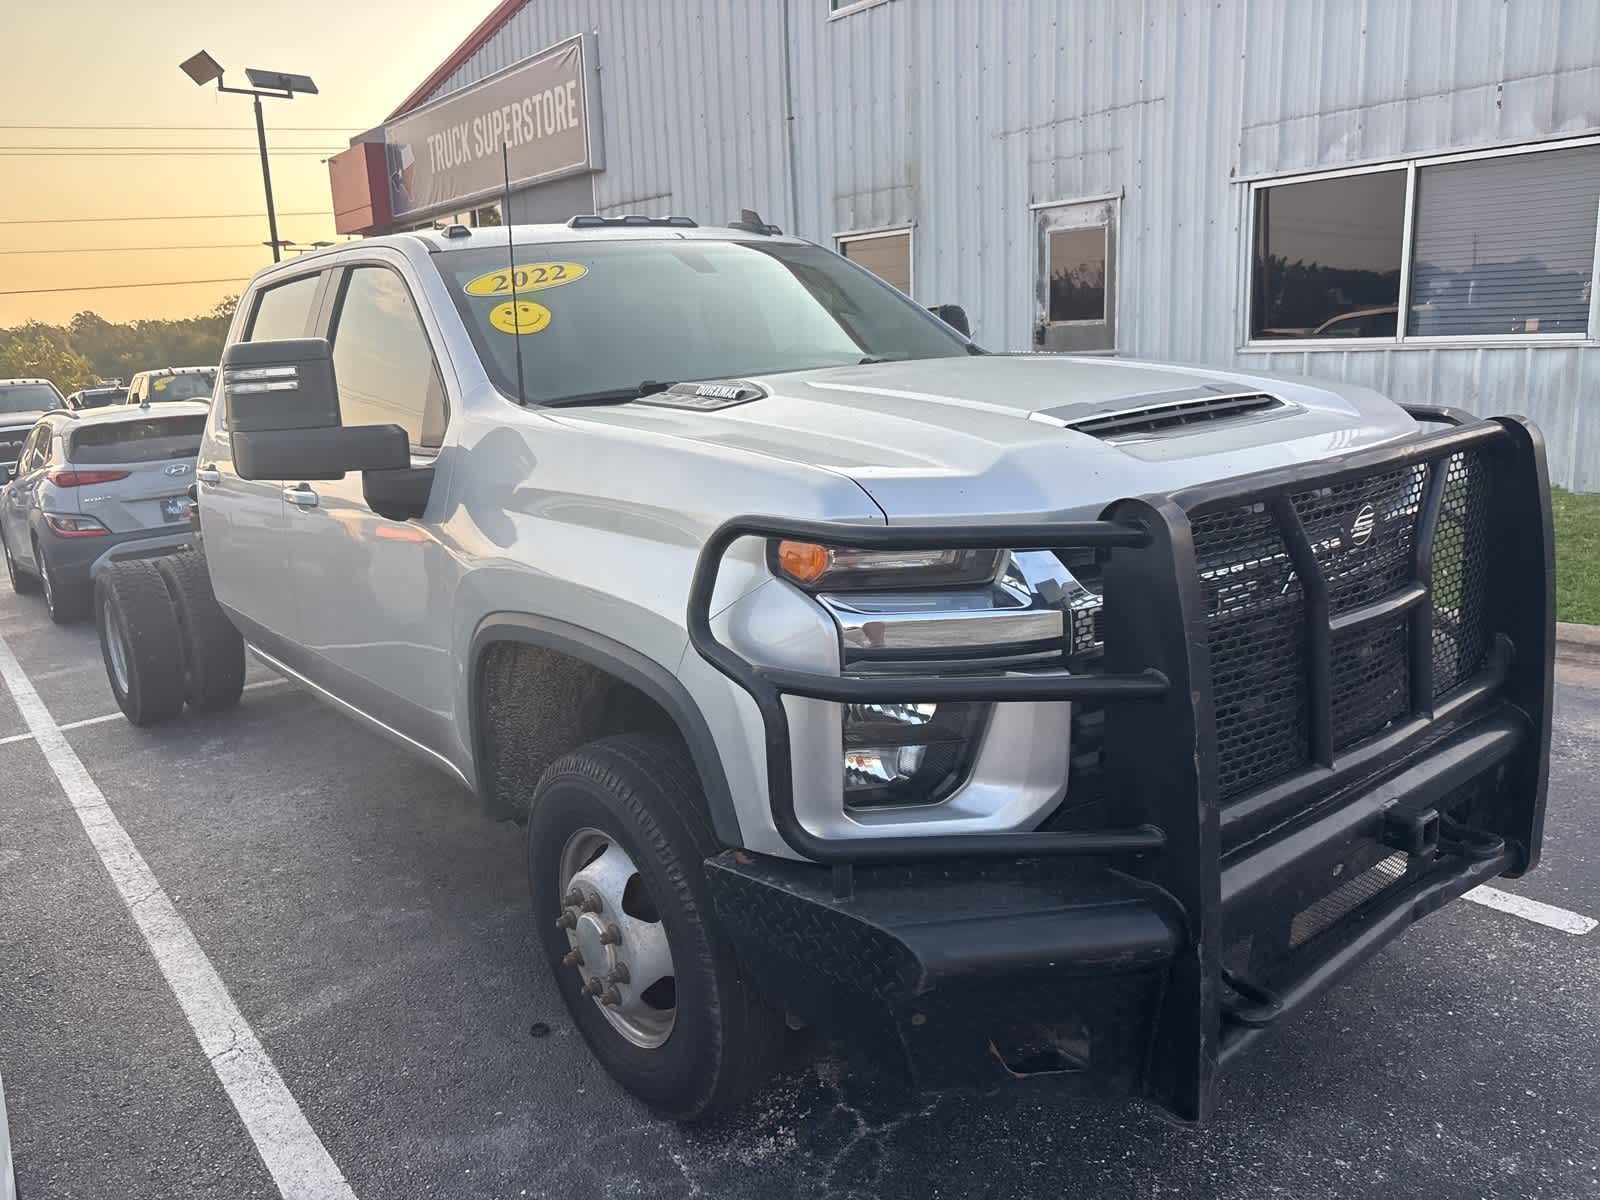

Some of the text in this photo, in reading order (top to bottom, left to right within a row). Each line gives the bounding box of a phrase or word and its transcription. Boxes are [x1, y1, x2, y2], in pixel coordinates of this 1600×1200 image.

[427, 79, 579, 175] TRUCK SUPERSTORE
[491, 265, 567, 293] 2022
